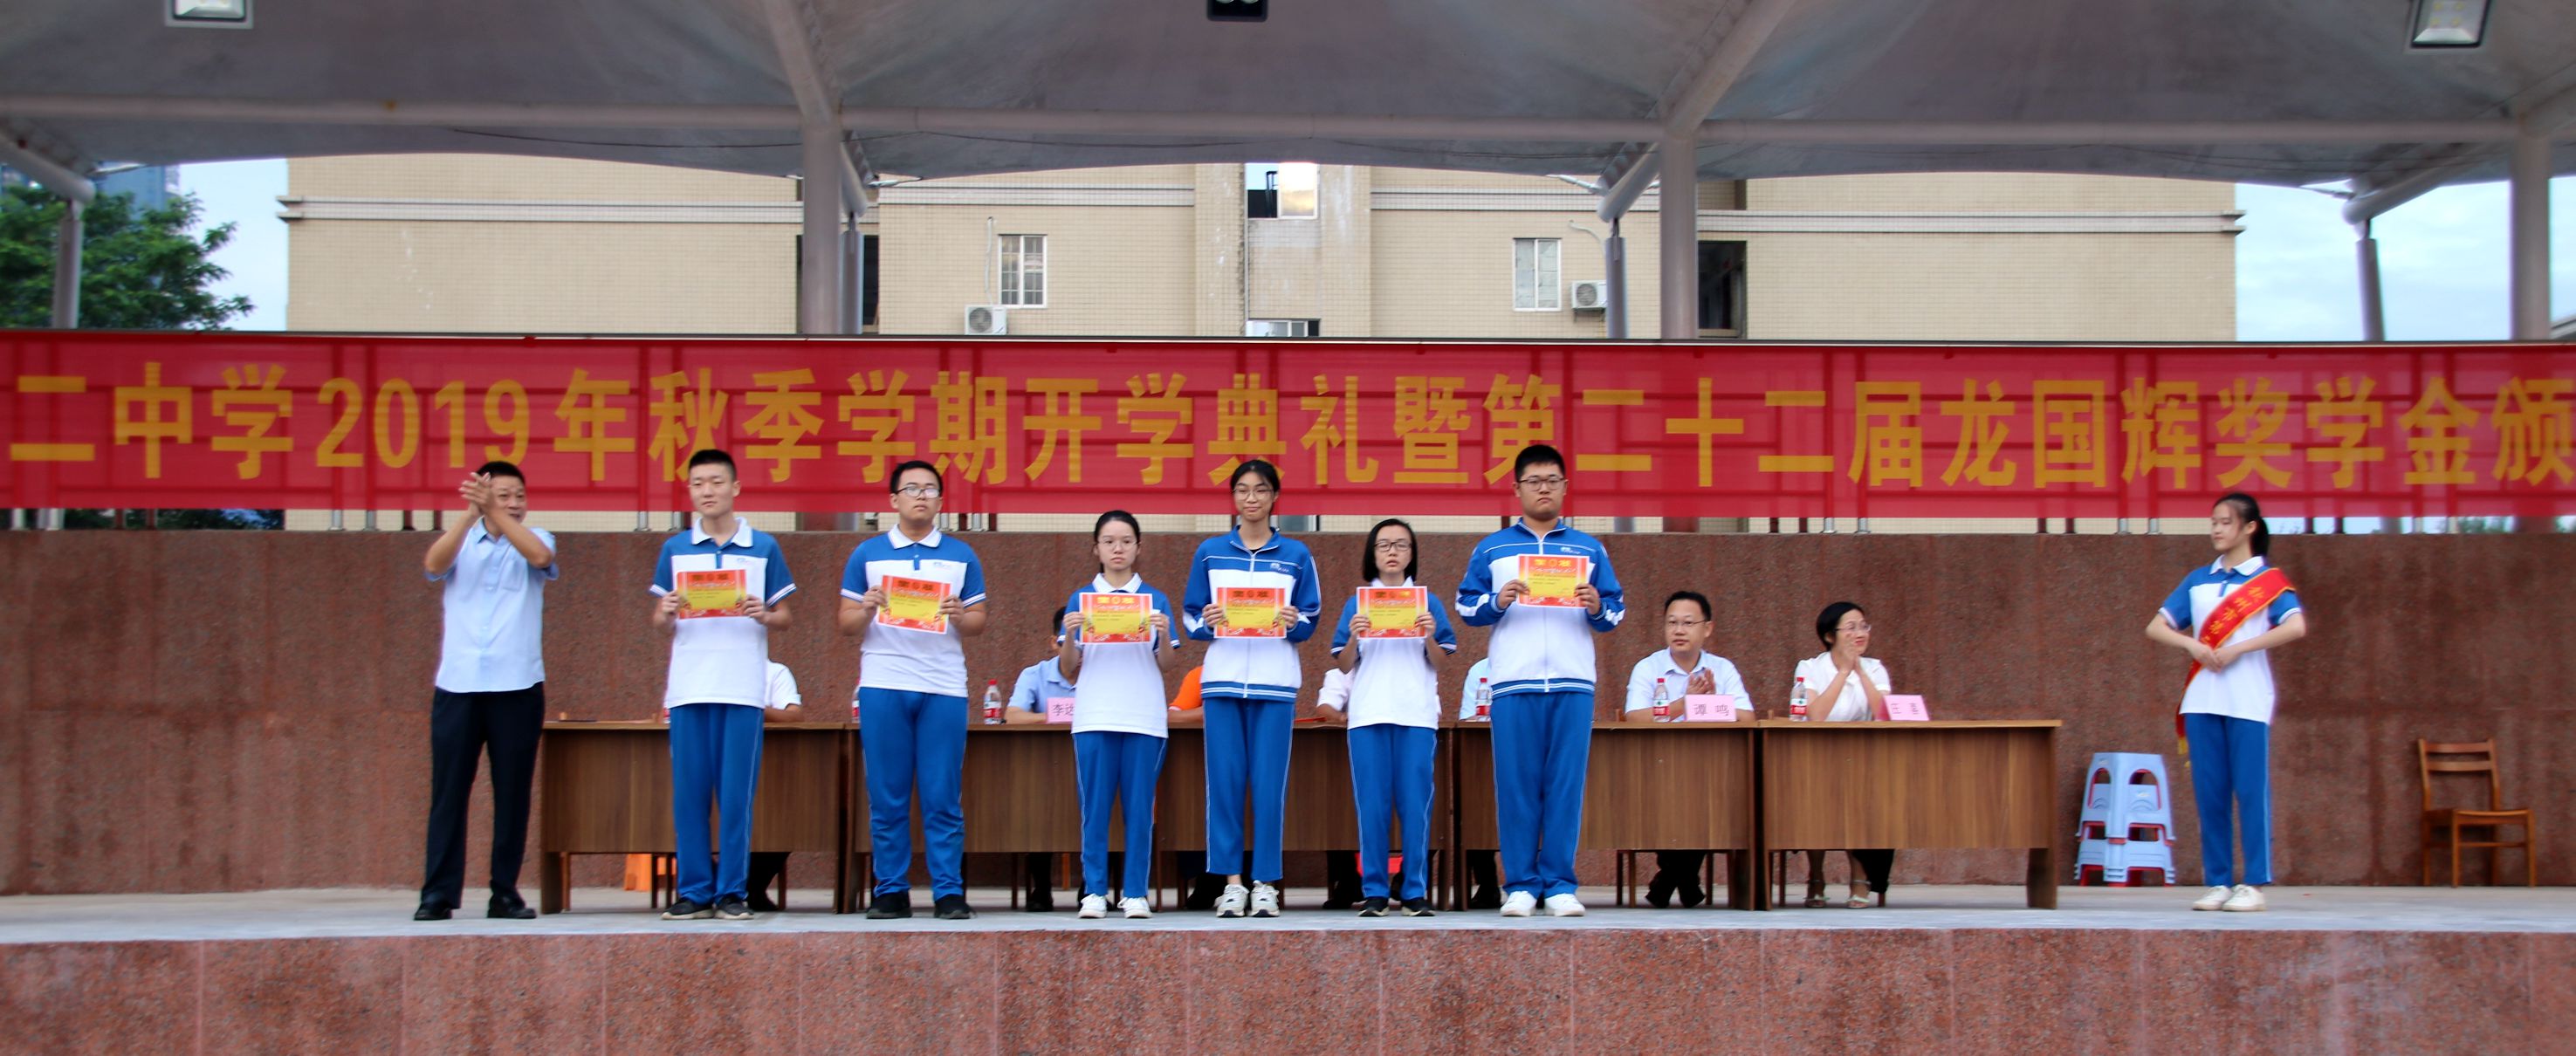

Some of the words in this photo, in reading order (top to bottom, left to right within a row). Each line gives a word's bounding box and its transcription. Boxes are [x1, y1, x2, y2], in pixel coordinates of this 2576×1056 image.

[10, 361, 2575, 489] 二中学2019年秋季学期开学典礼暨第二十二届龙国辉奖学金颁
